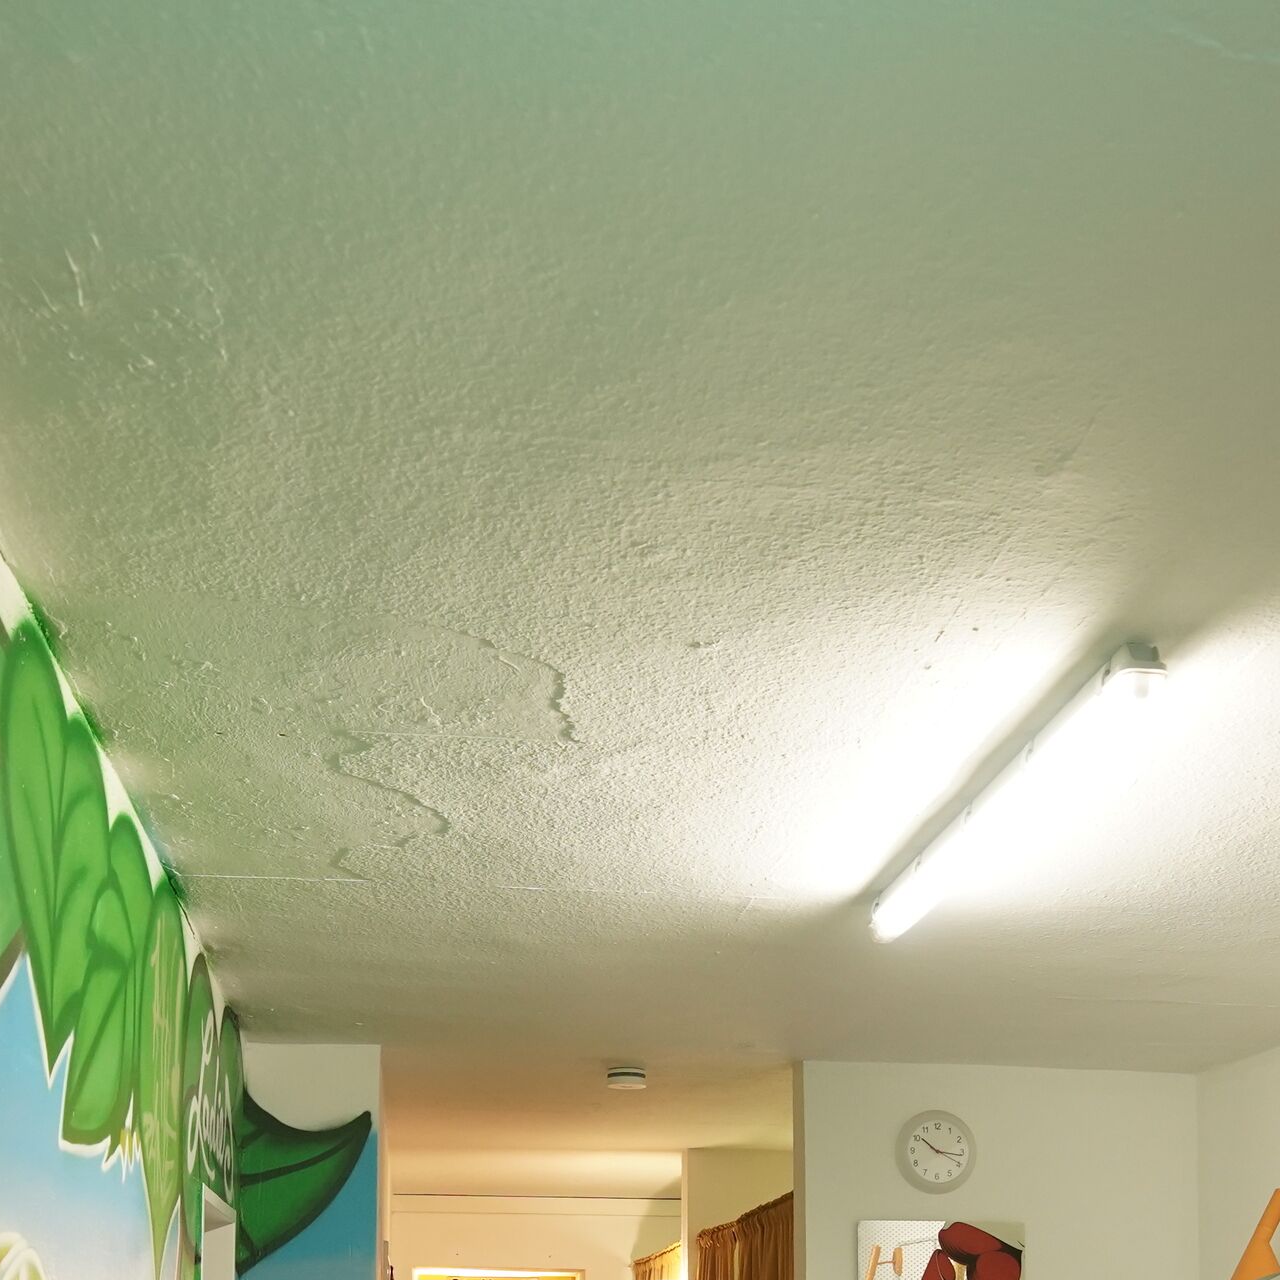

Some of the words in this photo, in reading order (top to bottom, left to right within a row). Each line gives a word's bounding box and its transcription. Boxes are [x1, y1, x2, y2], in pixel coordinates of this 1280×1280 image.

[934, 1122, 942, 1130] 12
[913, 1134, 921, 1142] 10
[910, 1147, 915, 1155] 9
